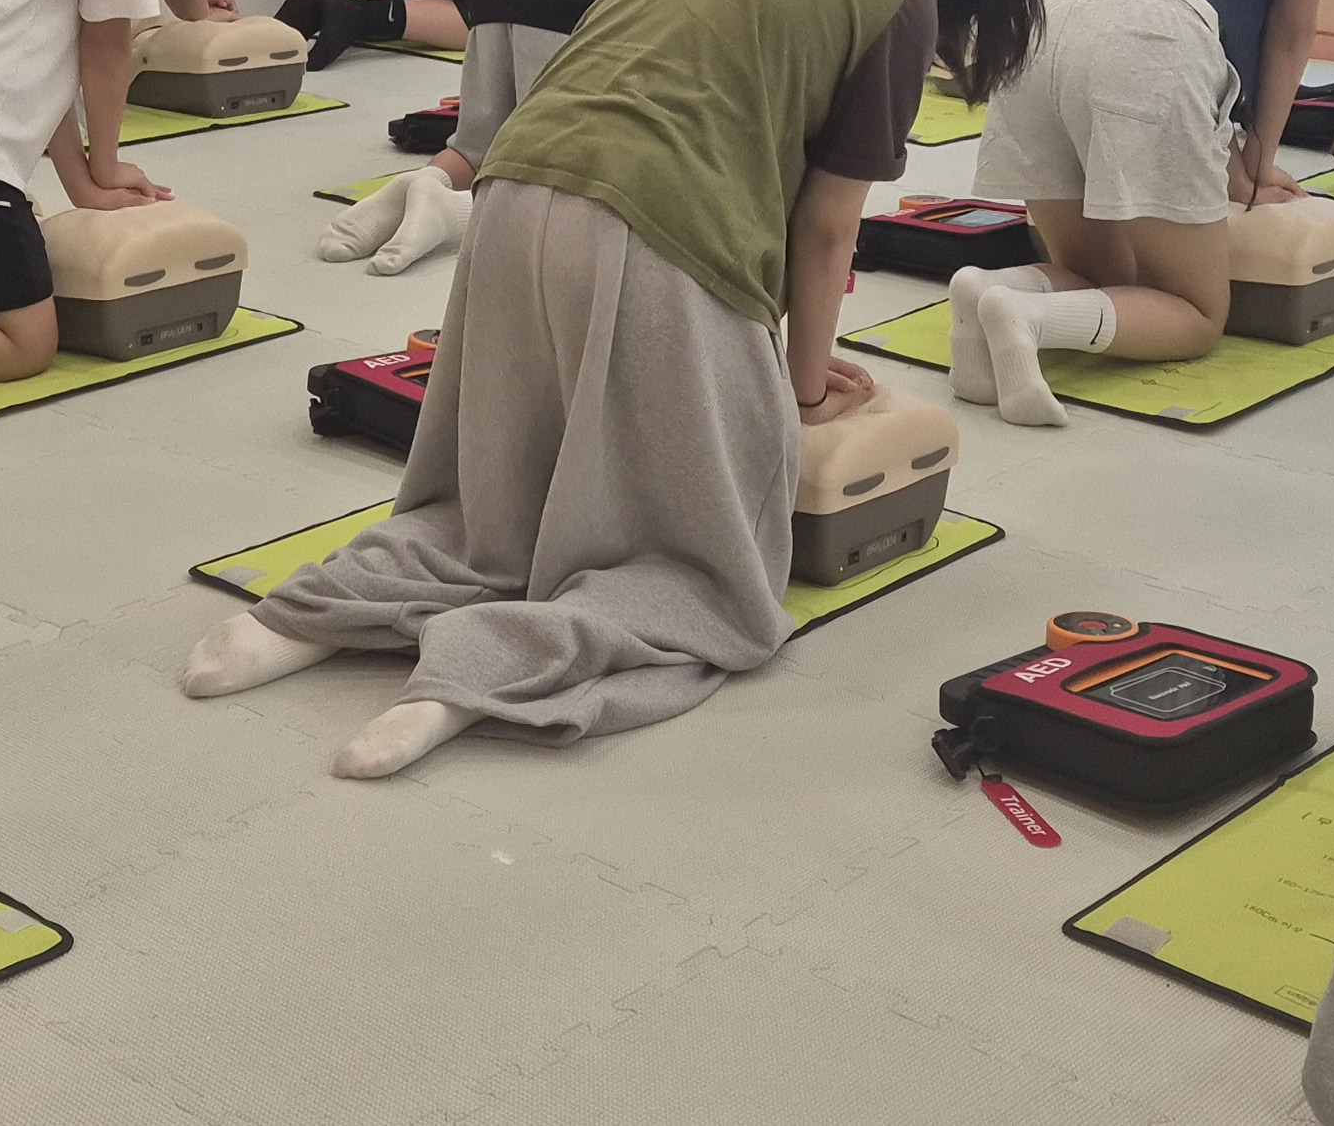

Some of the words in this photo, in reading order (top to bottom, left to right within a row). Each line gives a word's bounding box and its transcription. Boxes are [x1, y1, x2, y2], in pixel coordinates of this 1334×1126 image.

[363, 354, 410, 369] AED
[1014, 657, 1072, 683] AED
[1000, 795, 1047, 838] Trainer
